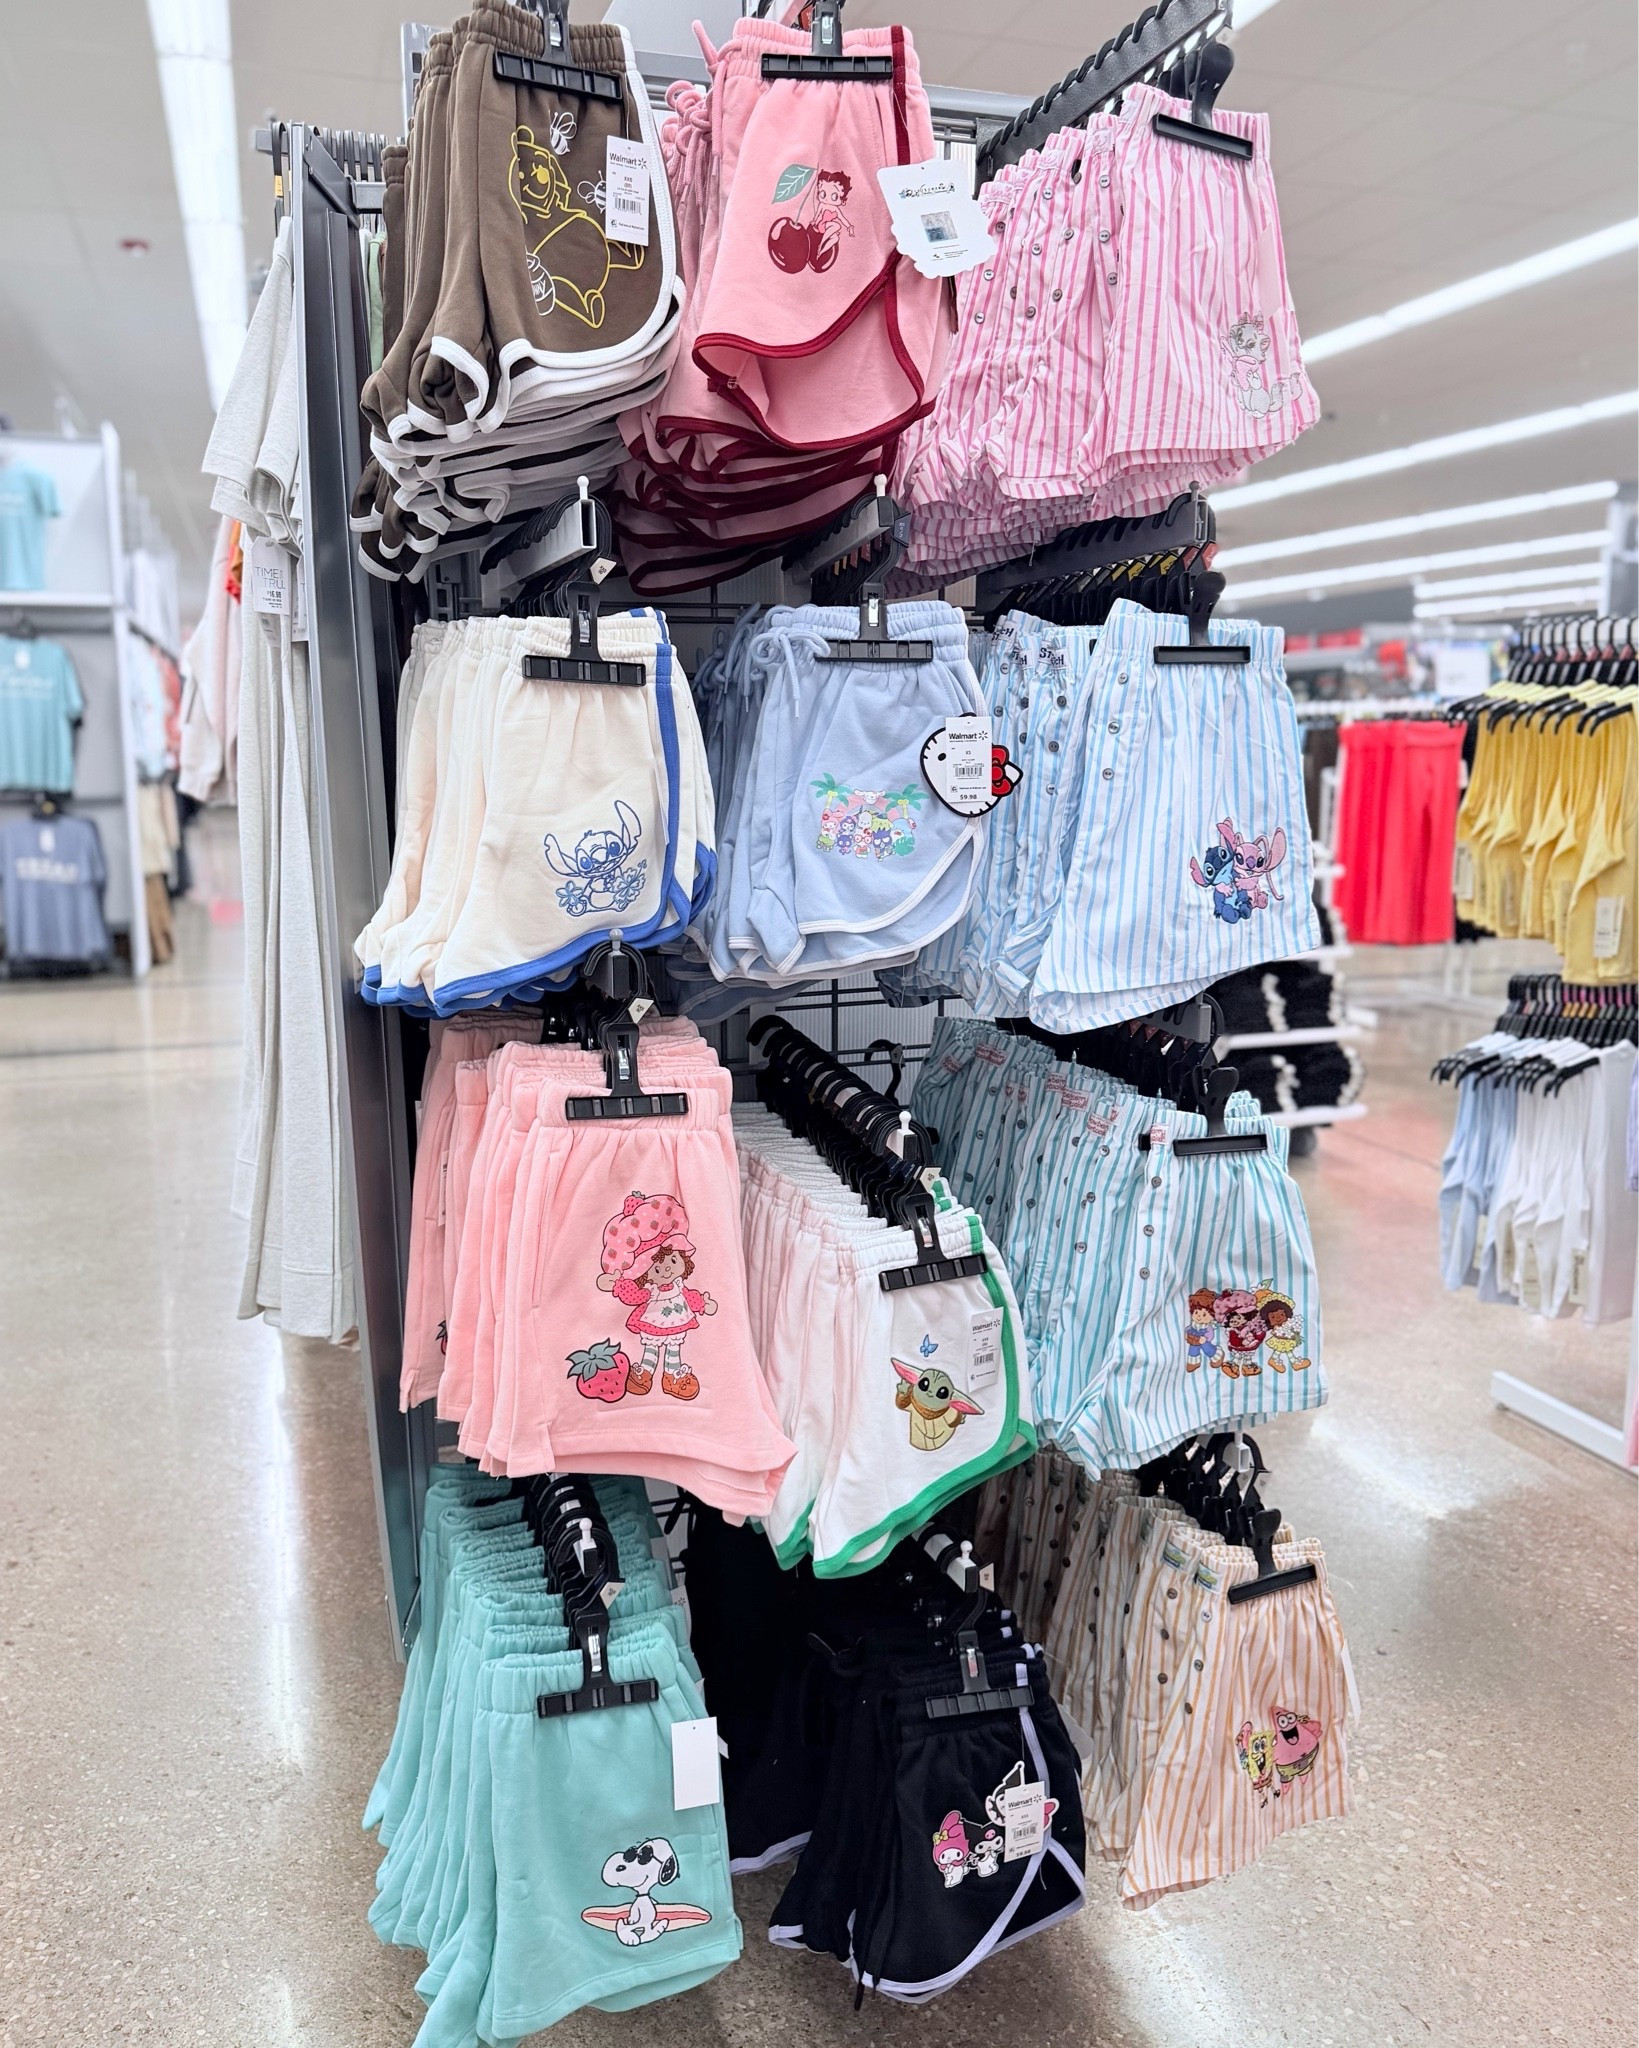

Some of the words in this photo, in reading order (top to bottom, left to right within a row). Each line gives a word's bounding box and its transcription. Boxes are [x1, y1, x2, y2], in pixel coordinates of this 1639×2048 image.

[610, 153, 637, 166] Walmart
[255, 567, 280, 579] TIME
[972, 1321, 993, 1331] Walmart
[1008, 1797, 1033, 1808] Walmart
